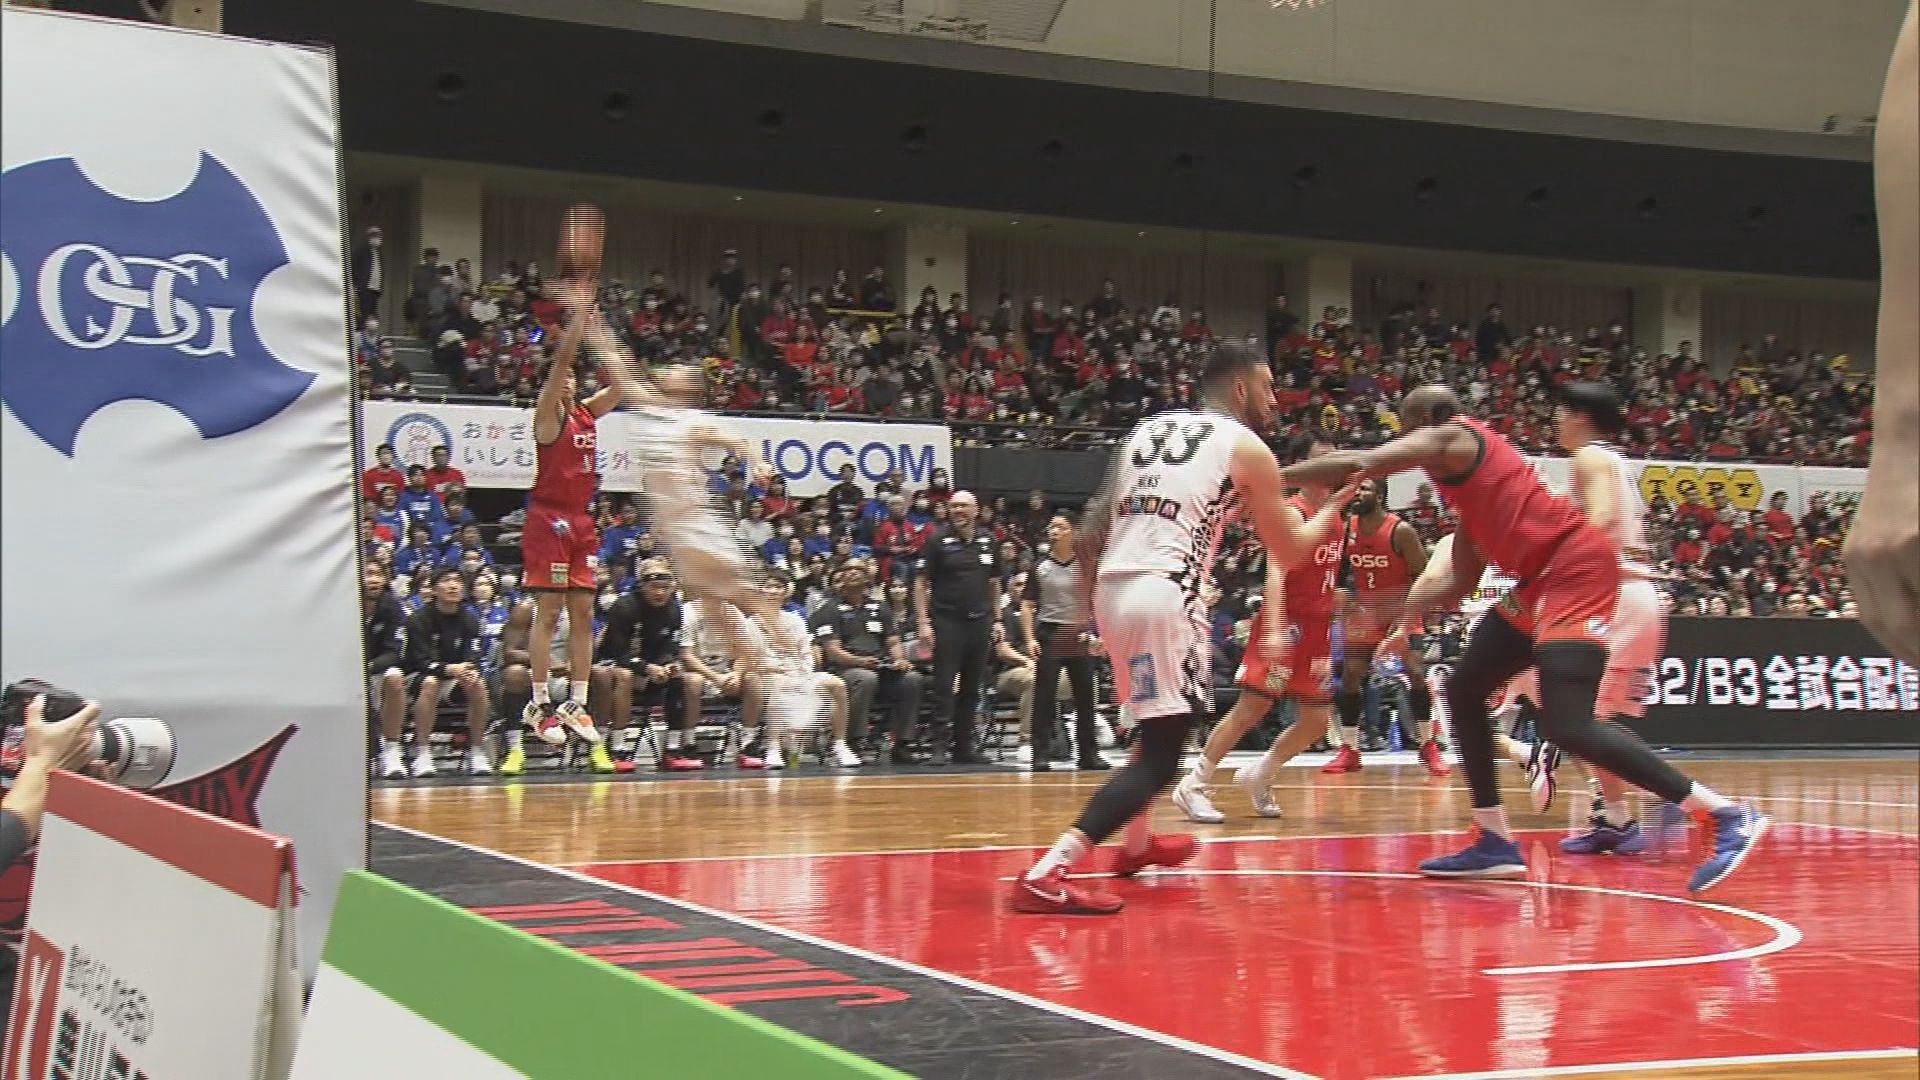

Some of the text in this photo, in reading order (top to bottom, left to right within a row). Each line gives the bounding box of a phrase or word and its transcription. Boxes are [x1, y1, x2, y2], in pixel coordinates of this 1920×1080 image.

[37, 243, 236, 356] OSG
[463, 421, 534, 441] おかざ
[573, 434, 597, 449] OS
[1132, 420, 1213, 467] 33
[1647, 480, 1754, 498] TOPY
[1349, 554, 1389, 568] OSG
[1367, 572, 1376, 588] 2
